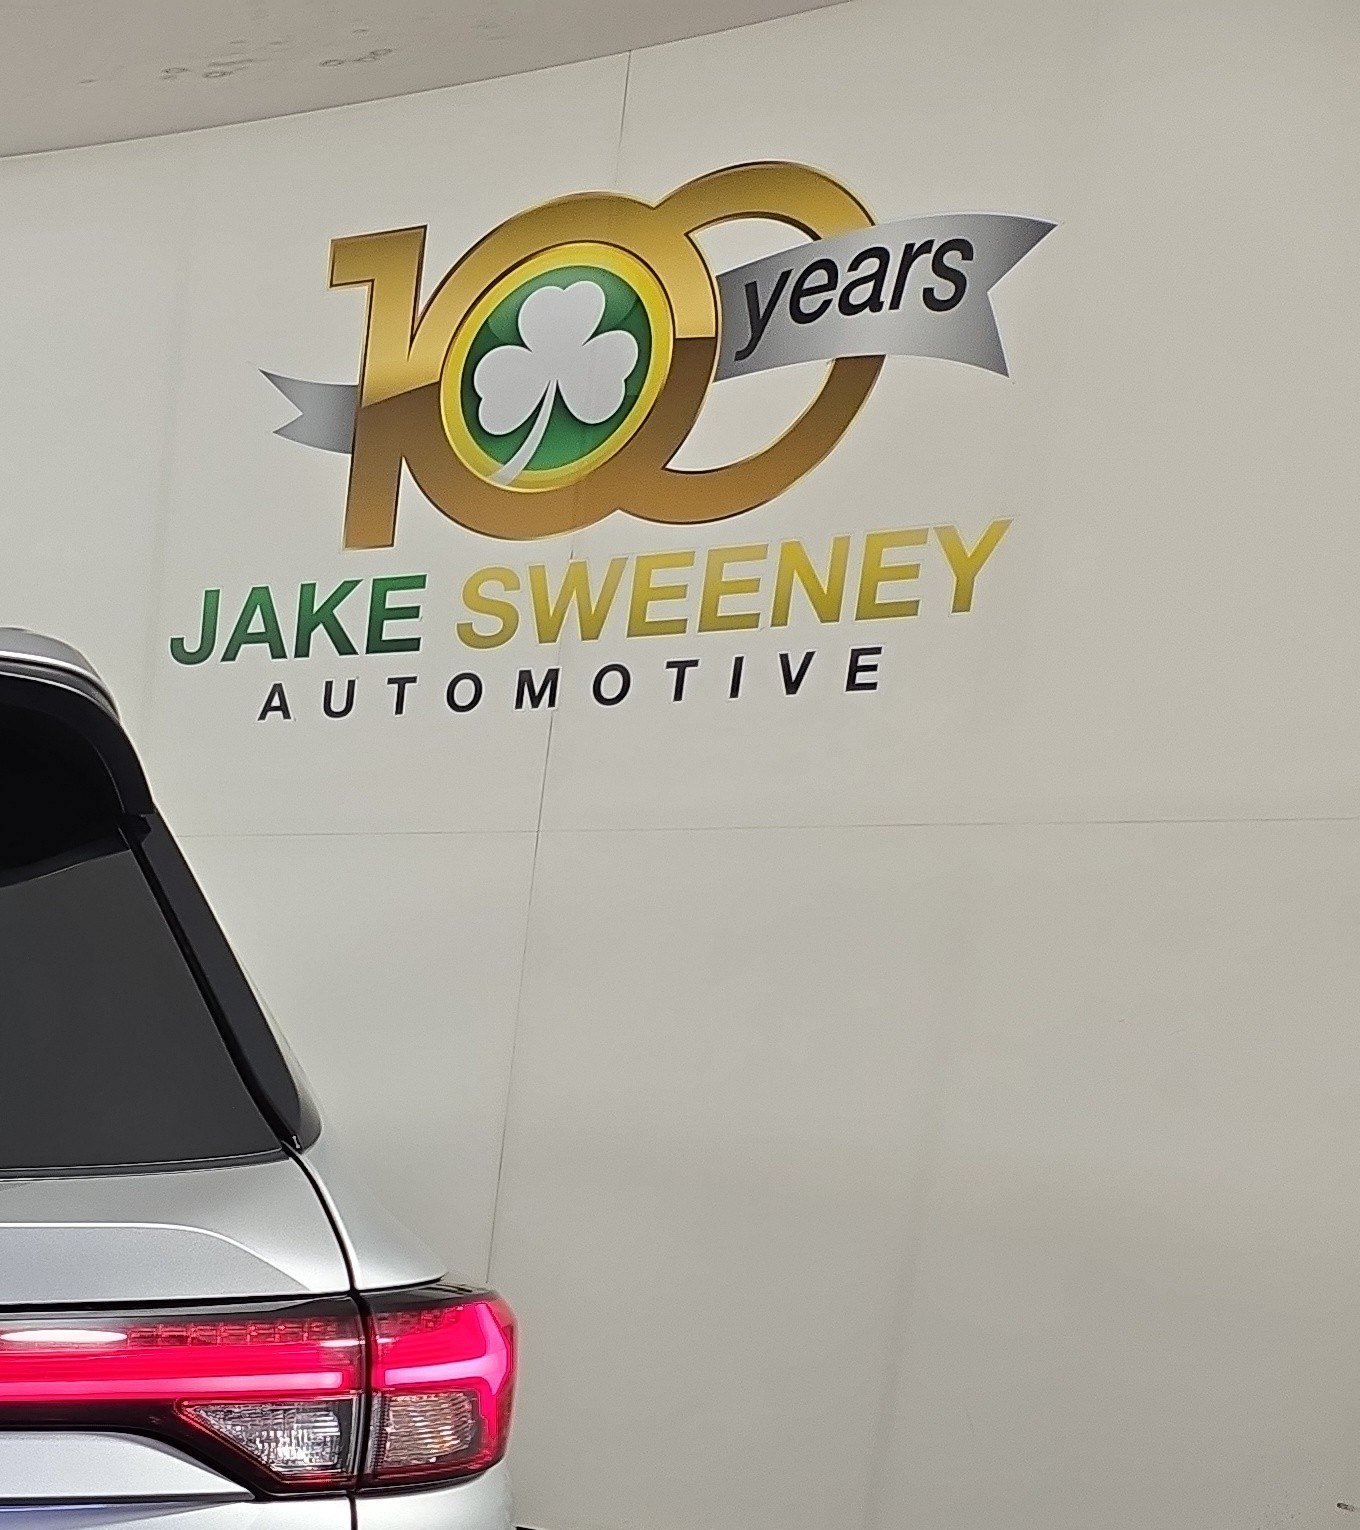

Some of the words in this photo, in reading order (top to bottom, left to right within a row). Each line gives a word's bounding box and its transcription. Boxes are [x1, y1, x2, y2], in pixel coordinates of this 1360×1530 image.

[328, 160, 886, 551] 100
[734, 234, 975, 362] years
[169, 573, 429, 666] JAKE
[455, 517, 1014, 651] SWEENEY
[257, 645, 884, 723] AUTOMOTIVE
